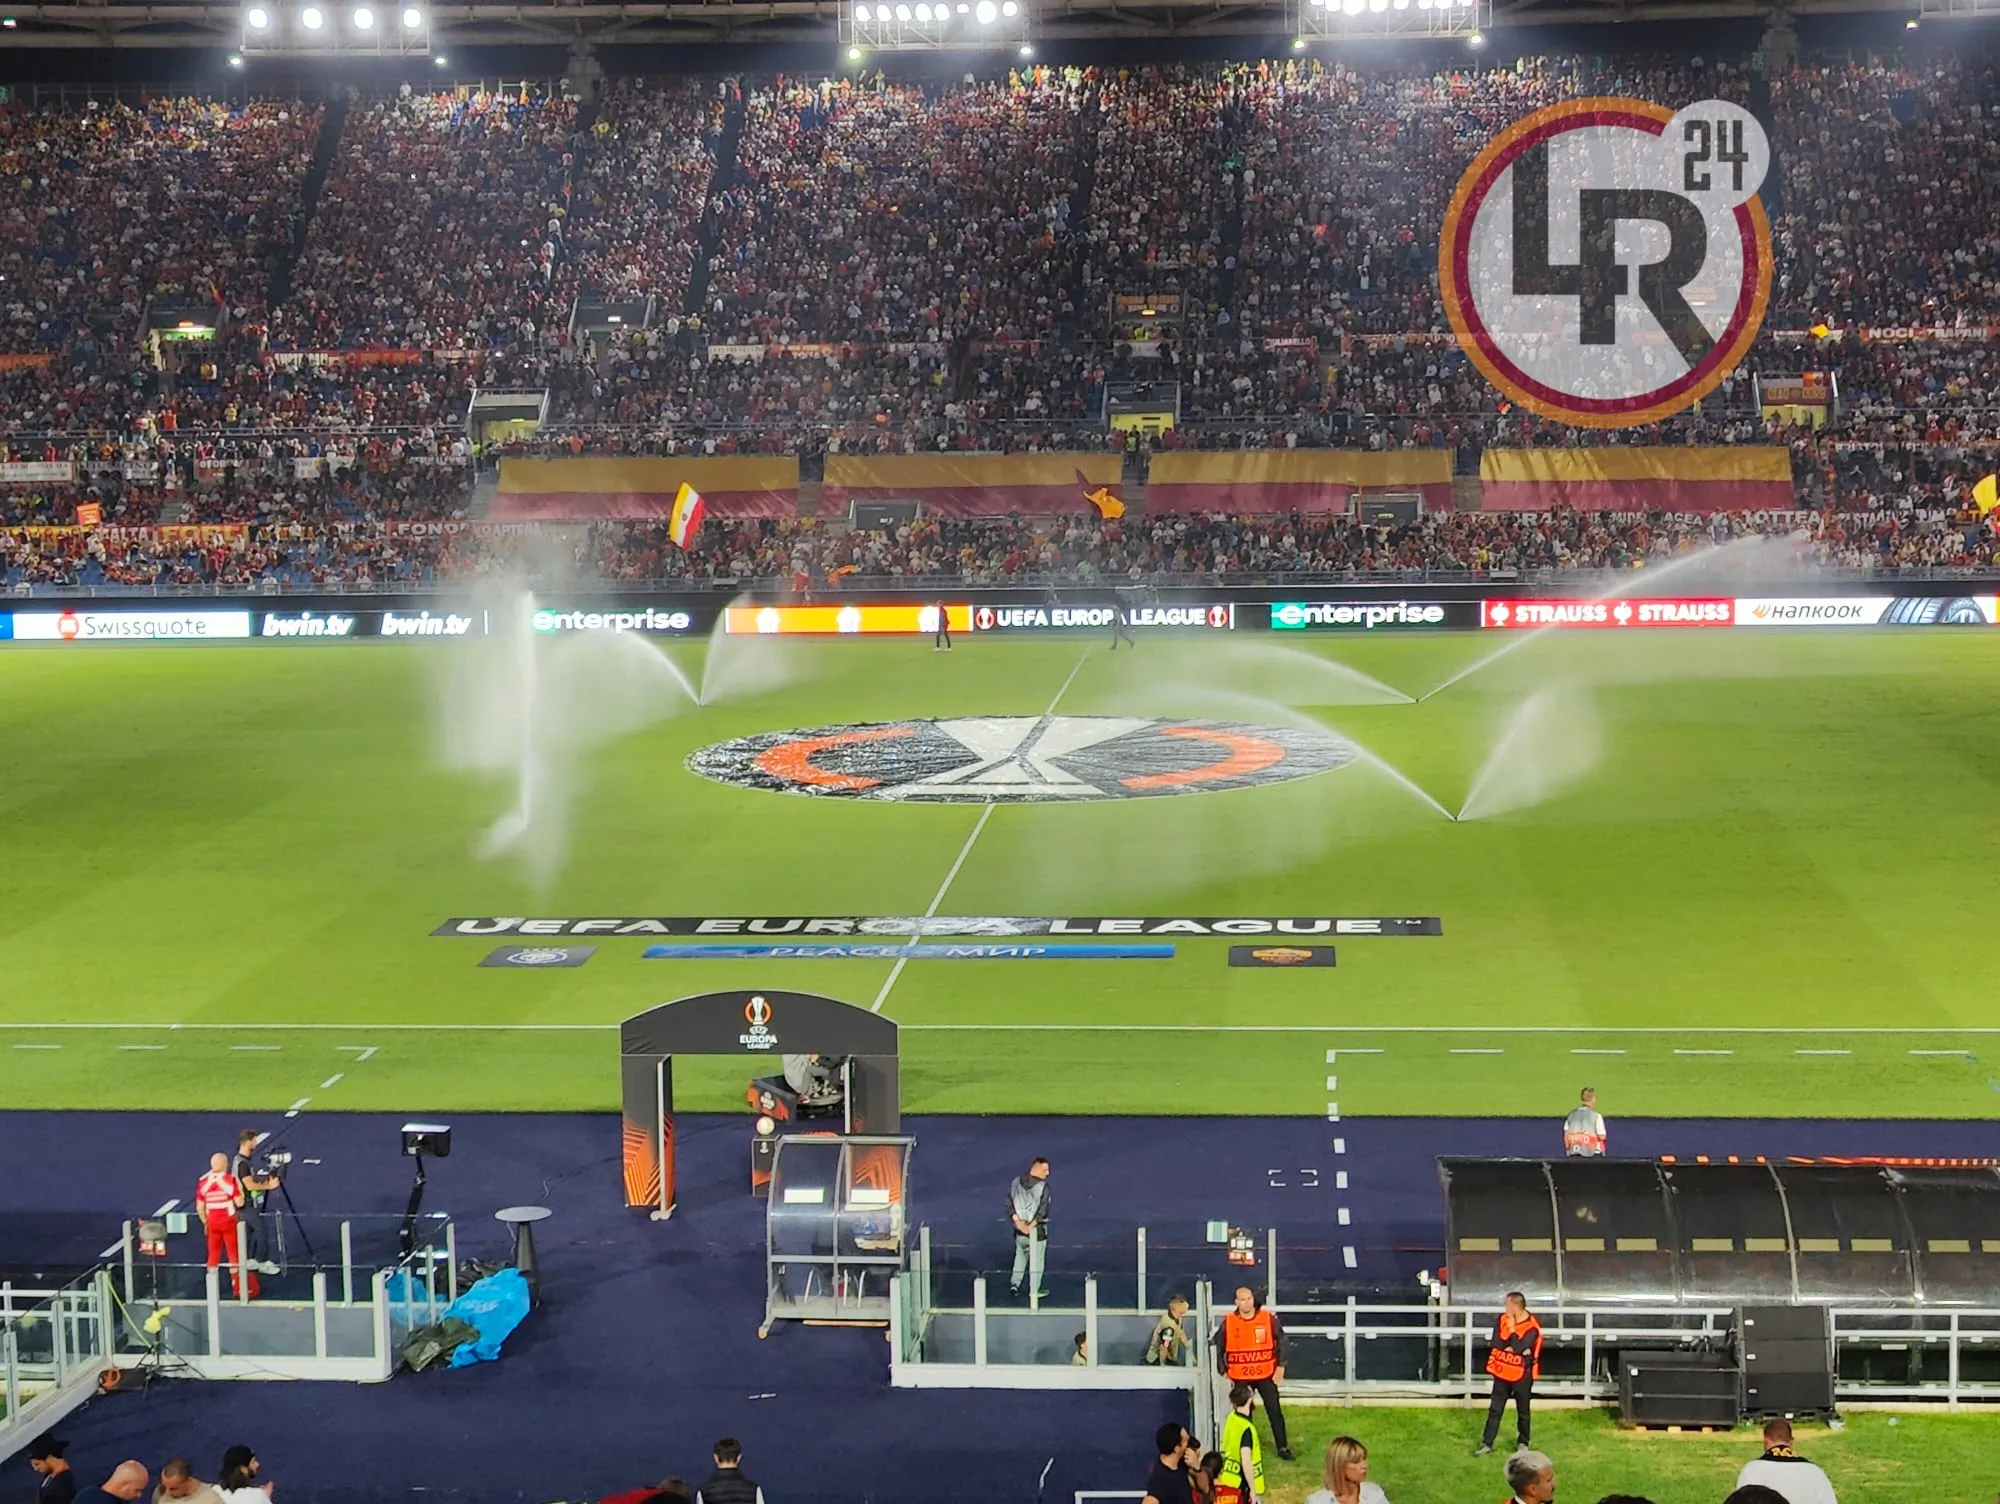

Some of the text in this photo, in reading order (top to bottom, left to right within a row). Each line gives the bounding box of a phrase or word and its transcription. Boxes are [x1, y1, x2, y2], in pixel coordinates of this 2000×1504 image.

[263, 612, 353, 637] bwin.tv
[380, 611, 472, 635] bwin.tv
[532, 608, 690, 633] enterprise
[997, 609, 1048, 626] UEFA
[1130, 608, 1205, 626] LEAGUE
[1272, 602, 1444, 628] enterprise
[1516, 603, 1729, 623] STRAUSS STRAUSS
[85, 616, 206, 639] Swissquote
[456, 919, 669, 934] UEFA
[1049, 918, 1382, 934] LEAGUE
[739, 1034, 778, 1044] EUROPA
